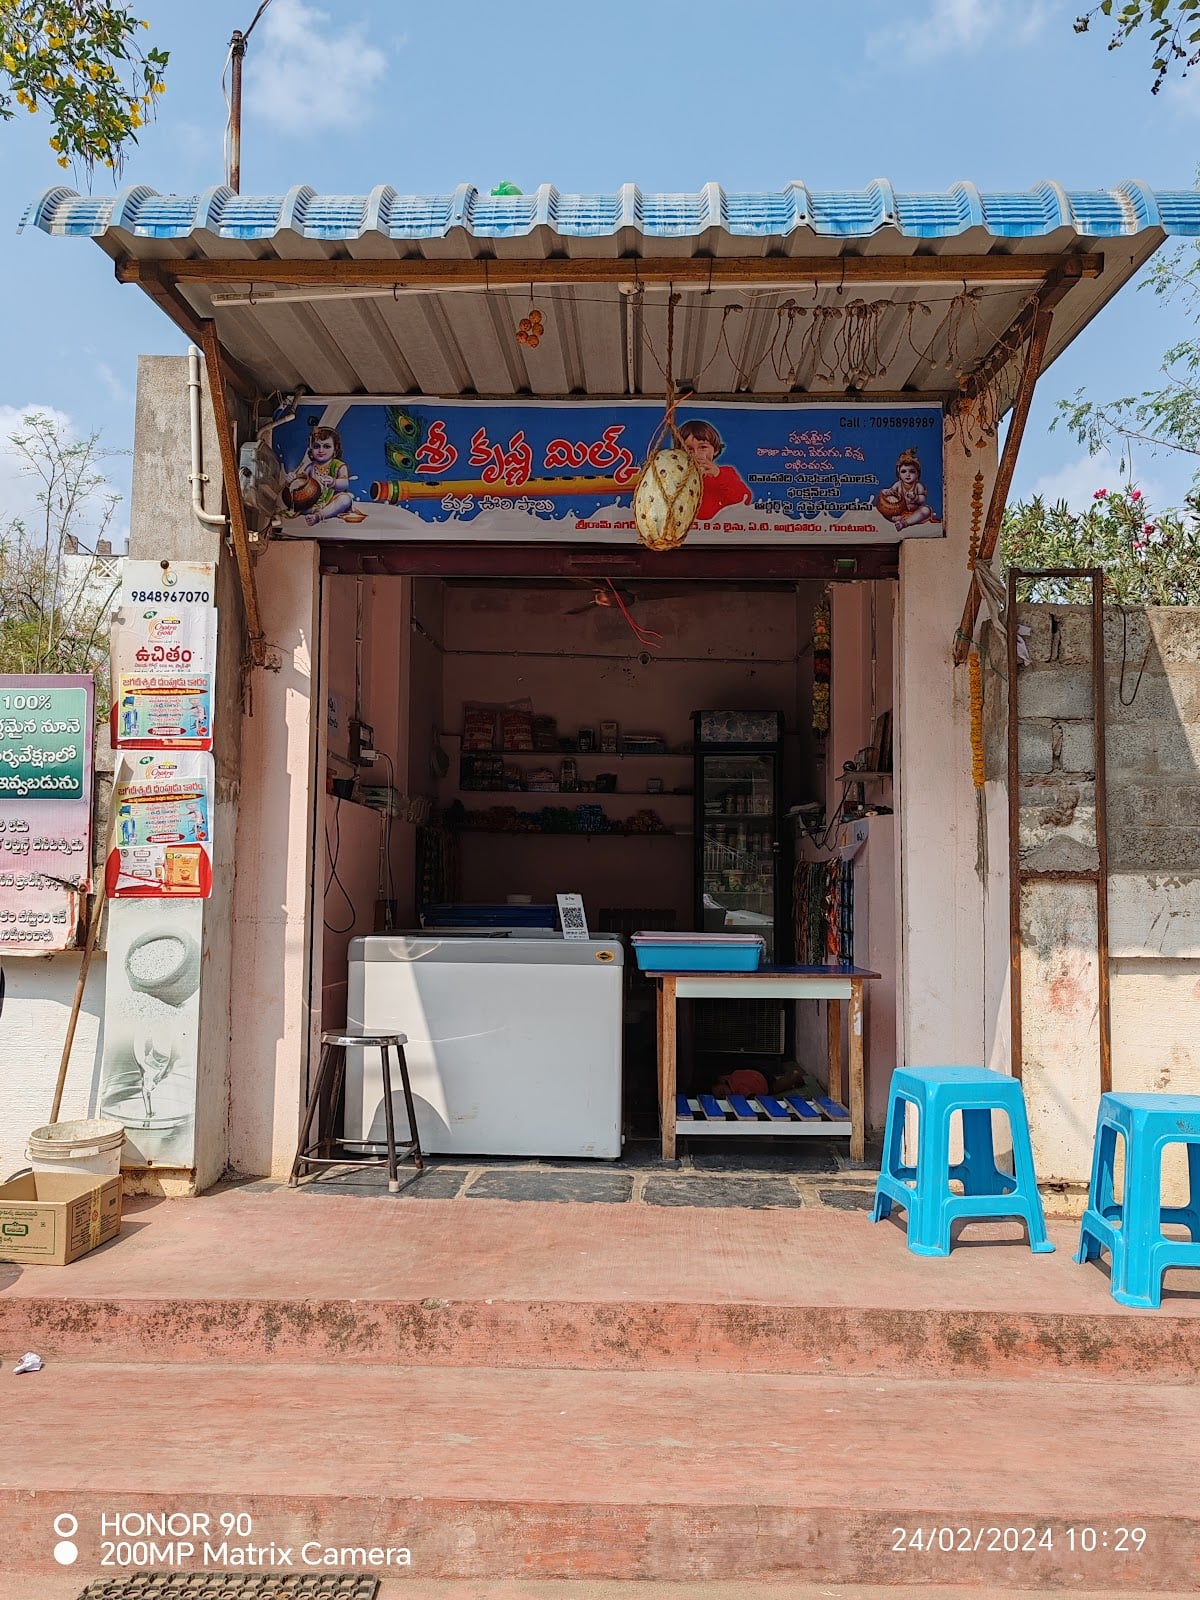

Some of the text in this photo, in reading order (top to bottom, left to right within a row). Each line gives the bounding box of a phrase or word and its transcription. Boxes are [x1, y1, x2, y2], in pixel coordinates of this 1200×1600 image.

[839, 417, 860, 428] Call
[869, 417, 935, 428] 7095898989
[416, 421, 640, 486] శ్రీ కృష్ణ మిల్క్
[441, 493, 555, 513] మన ఊరి పాలు
[704, 522, 711, 531] 8
[131, 591, 210, 602] 9848967070
[135, 645, 192, 662] ఉచితం
[3, 695, 51, 709] 100%
[0, 718, 80, 739] మైన నూనె
[0, 745, 76, 768] ర్యవేక్షణలో
